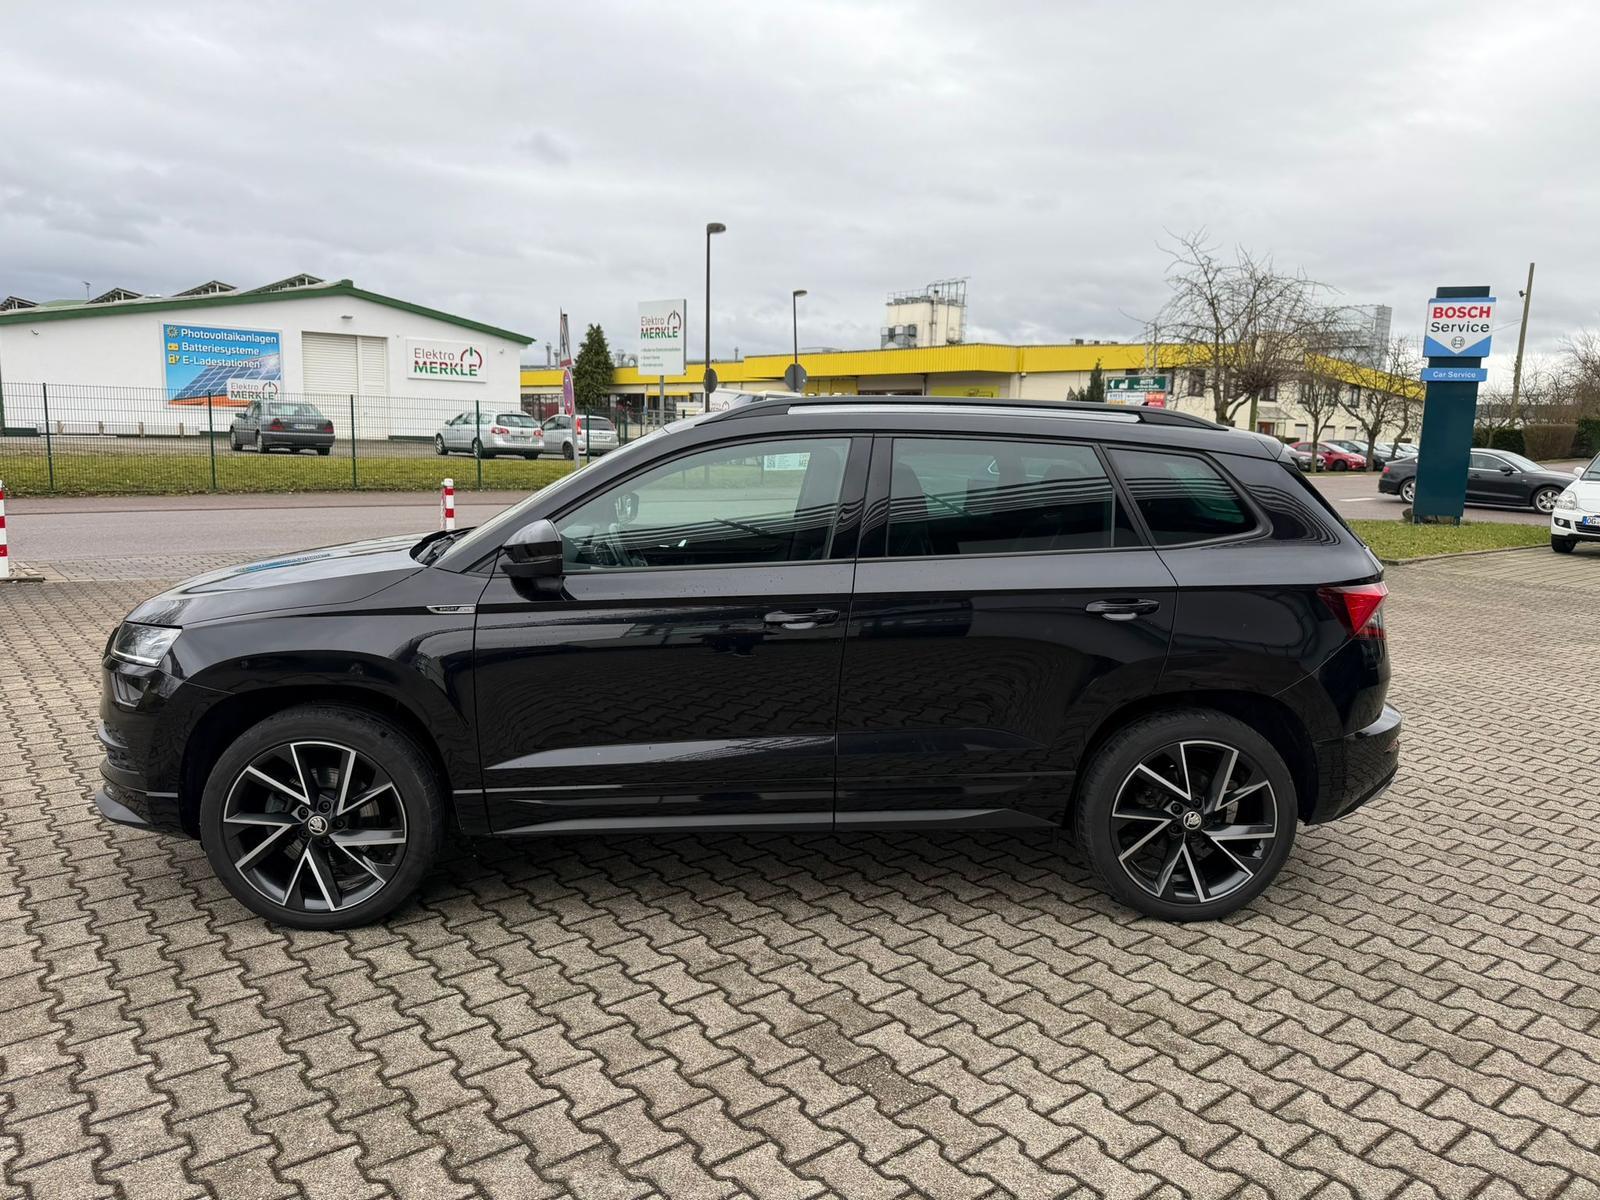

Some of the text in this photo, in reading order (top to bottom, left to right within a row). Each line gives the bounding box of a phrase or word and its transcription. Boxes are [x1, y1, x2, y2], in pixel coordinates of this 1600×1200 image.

[1432, 306, 1491, 319] BOSCH
[640, 315, 665, 327] Elektro
[1430, 320, 1490, 333] Service
[181, 328, 277, 344] Photovoltaikanlagen
[640, 326, 679, 340] MERKLE
[181, 342, 260, 356] Batteriesysteme
[413, 347, 455, 361] Elektro
[182, 355, 261, 368] E-Ladestationen
[413, 360, 478, 377] MERKLE
[1432, 370, 1476, 378] Car Service
[230, 382, 259, 390] Elektro
[230, 390, 275, 400] MERKLE
